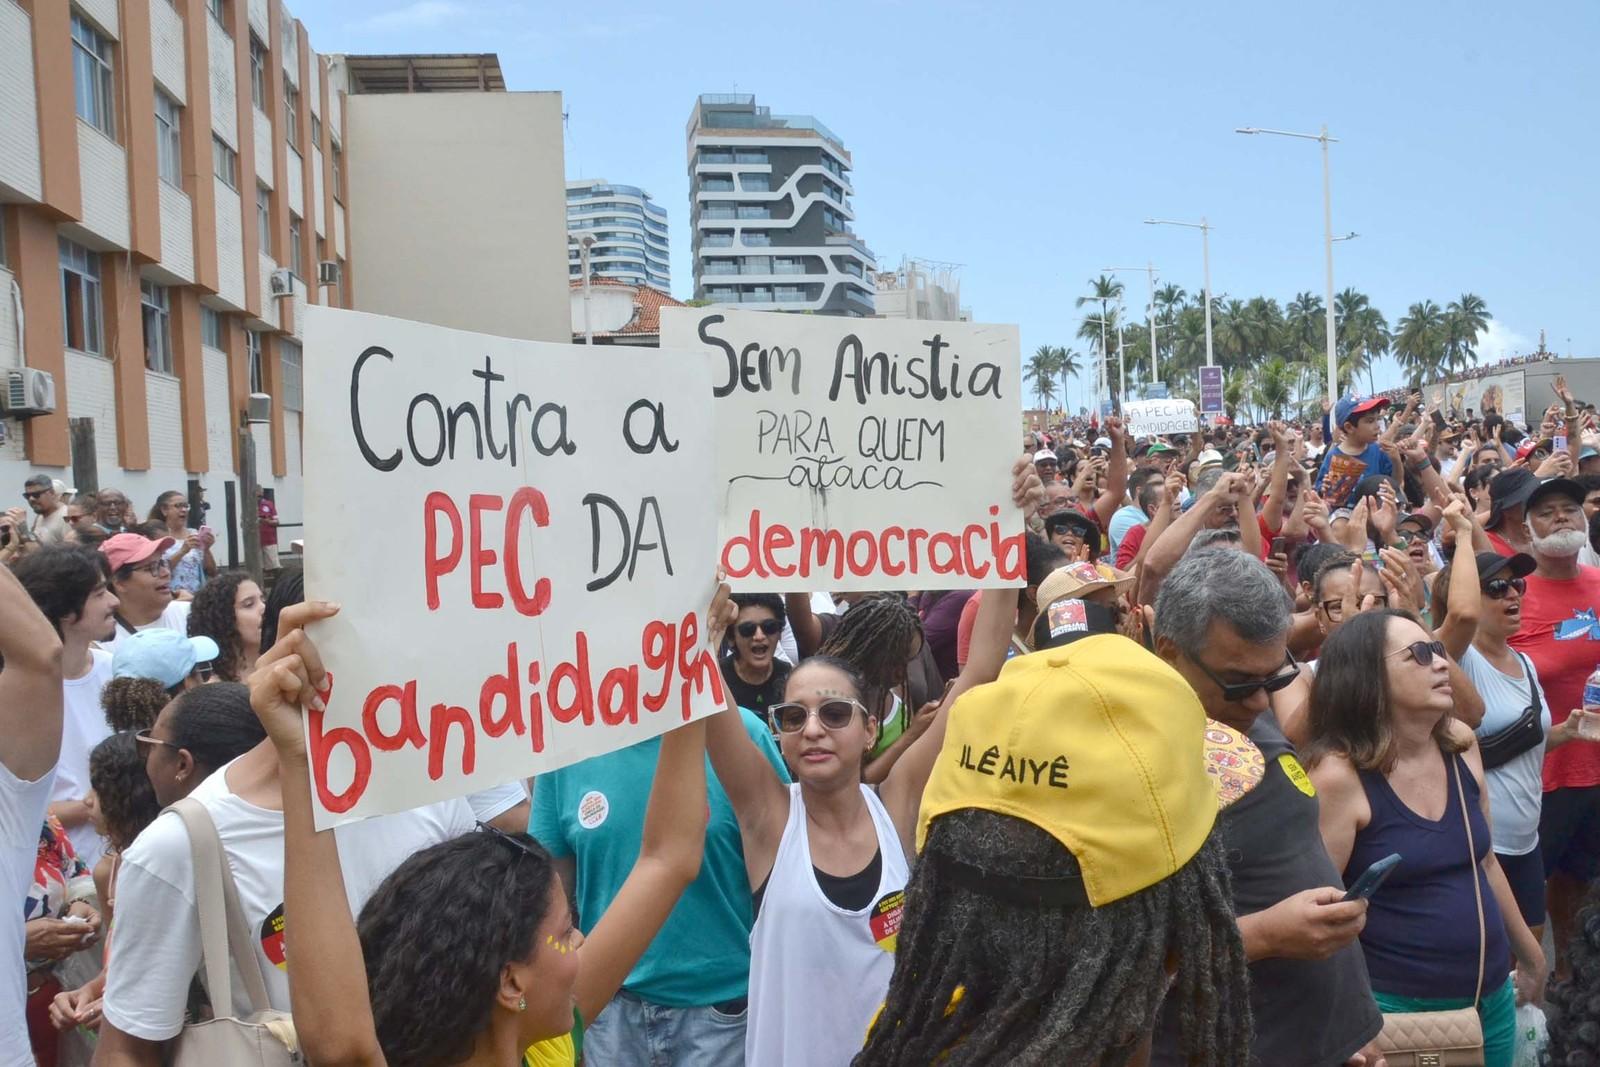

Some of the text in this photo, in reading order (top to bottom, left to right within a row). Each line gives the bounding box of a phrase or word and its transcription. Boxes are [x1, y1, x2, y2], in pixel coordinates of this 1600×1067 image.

[828, 333, 1003, 405] Anistia
[350, 346, 680, 472] Contra a
[756, 409, 946, 463] PARA QUEM
[1129, 419, 1197, 435] BANDIDAGEM
[1145, 406, 1172, 417] PEC
[786, 455, 912, 491] ataca
[423, 487, 674, 616] PEC DA
[720, 504, 1028, 581] democracia
[307, 611, 724, 814] bandidagem
